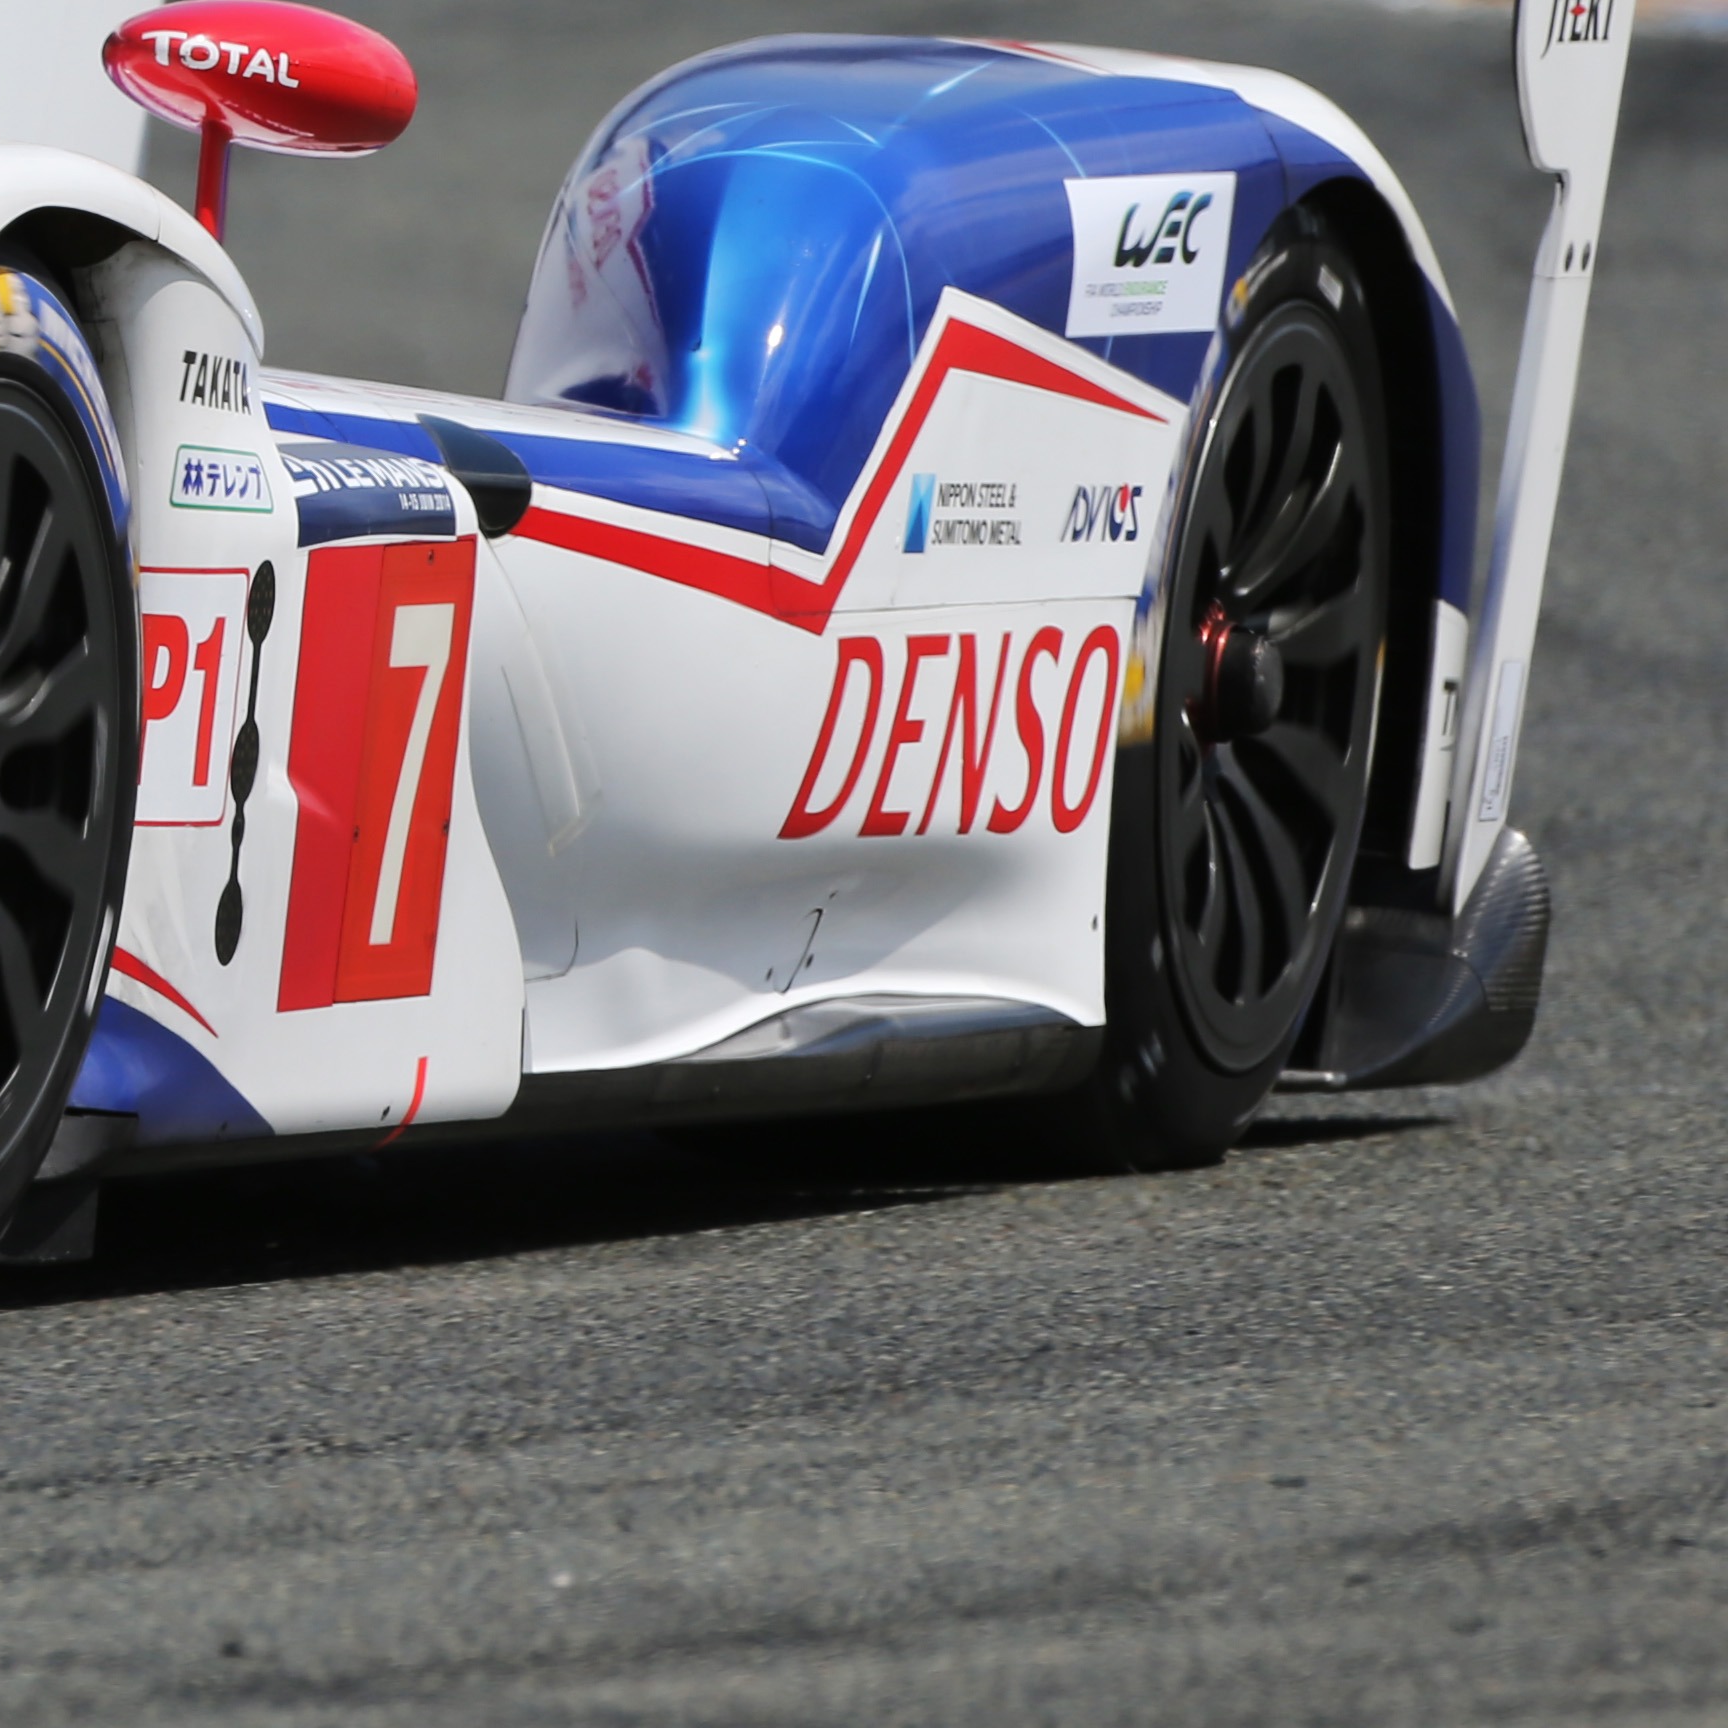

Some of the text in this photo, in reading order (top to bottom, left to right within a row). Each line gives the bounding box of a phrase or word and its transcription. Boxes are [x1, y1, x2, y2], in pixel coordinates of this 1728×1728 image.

[141, 30, 299, 88] TOTAL
[1113, 190, 1213, 268] WEC
[180, 350, 251, 415] TAKATA
[977, 483, 1006, 508] STEEL
[138, 612, 227, 787] P1
[777, 625, 1120, 839] DENSO
[369, 603, 455, 946] 7
